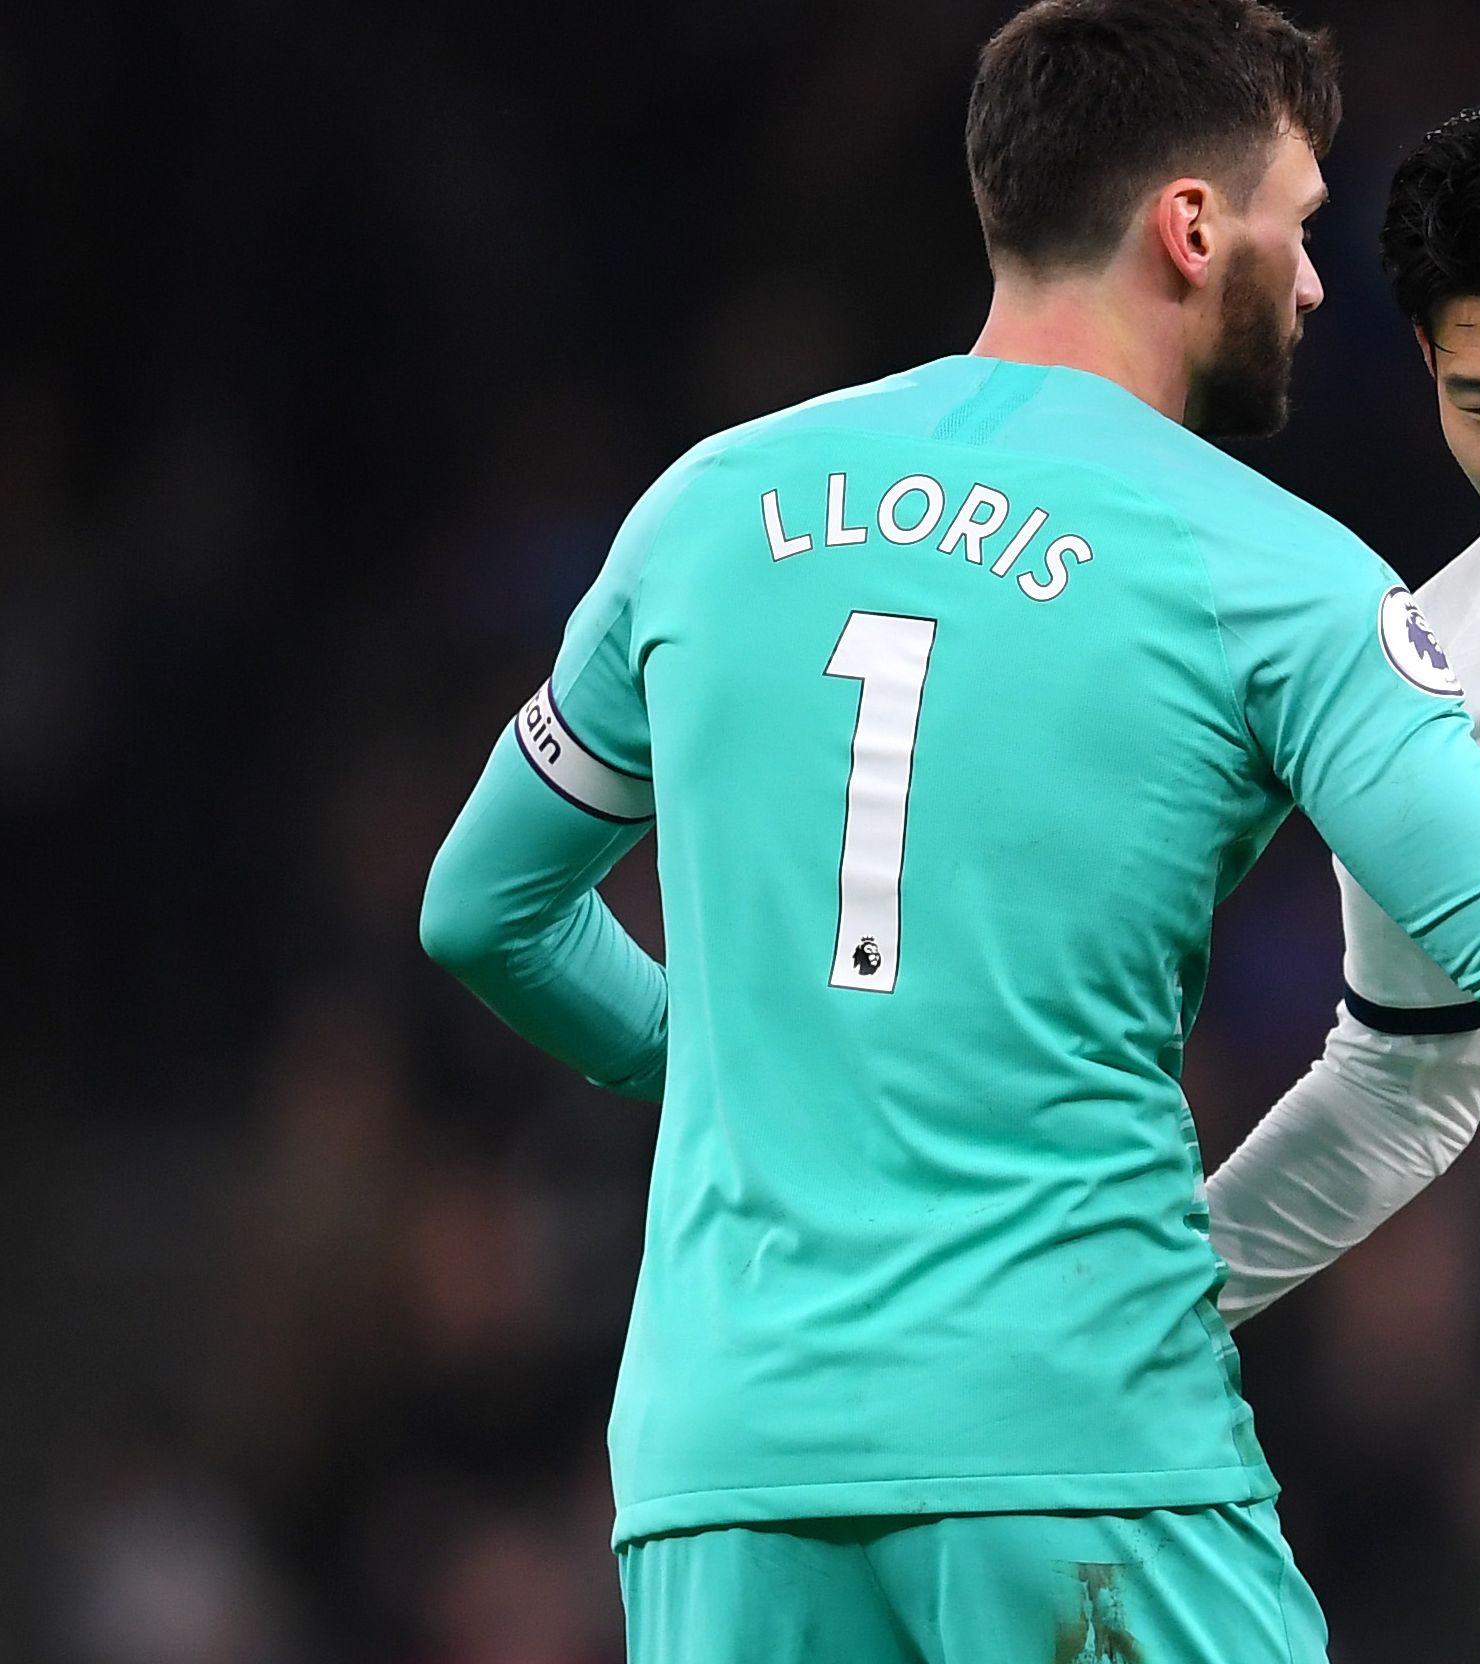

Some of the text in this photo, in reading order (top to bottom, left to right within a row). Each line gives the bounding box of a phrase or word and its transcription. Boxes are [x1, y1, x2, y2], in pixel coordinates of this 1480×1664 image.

[761, 472, 1093, 602] LLORIS
[526, 692, 562, 765] ain
[823, 609, 938, 994] 1
